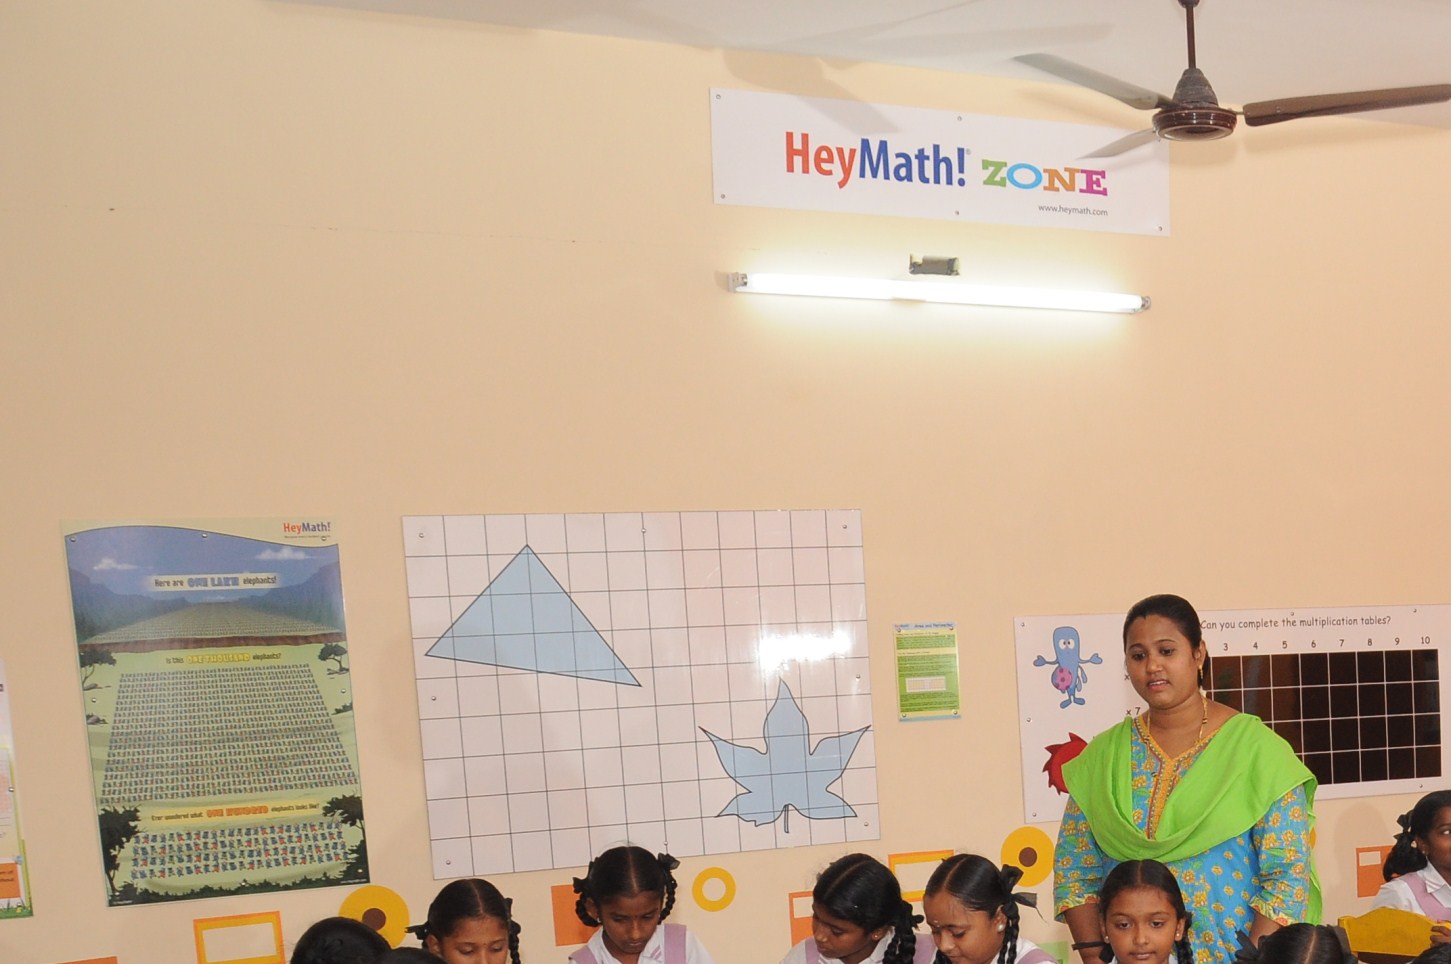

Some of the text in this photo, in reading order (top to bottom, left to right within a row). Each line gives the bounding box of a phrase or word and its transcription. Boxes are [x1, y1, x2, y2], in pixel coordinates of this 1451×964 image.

[785, 130, 1108, 197] HeyMath! ZONE
[1038, 204, 1108, 217] www.heymath.com
[283, 521, 331, 535] HeyMath!
[187, 577, 208, 588] ONE
[1200, 615, 1392, 632] Can you complete the multiplication tables?
[1223, 636, 1430, 652] 3 4 5 6 7 8 9 10
[1135, 706, 1141, 716] 7
